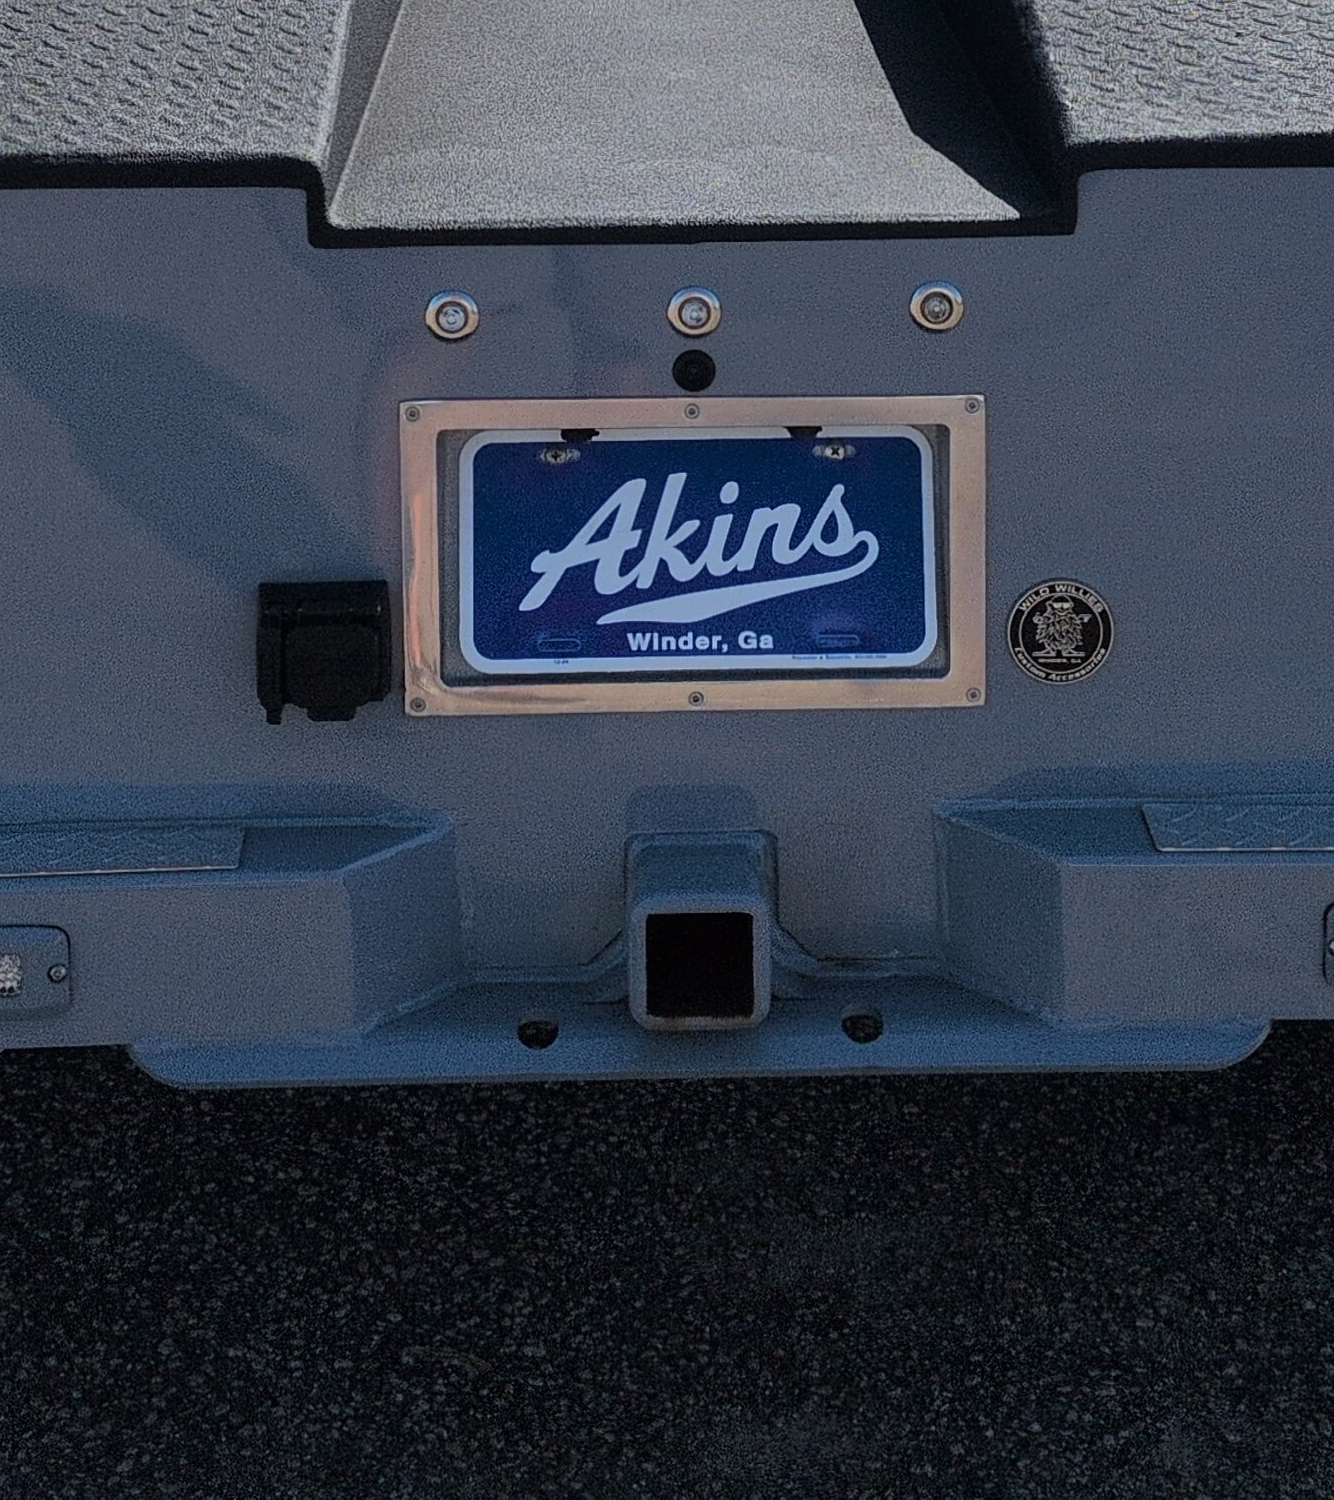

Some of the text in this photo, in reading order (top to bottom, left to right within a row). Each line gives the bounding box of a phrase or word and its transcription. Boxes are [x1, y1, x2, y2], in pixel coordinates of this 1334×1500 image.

[518, 472, 880, 625] Akins
[626, 630, 774, 653] Winder, Ga
